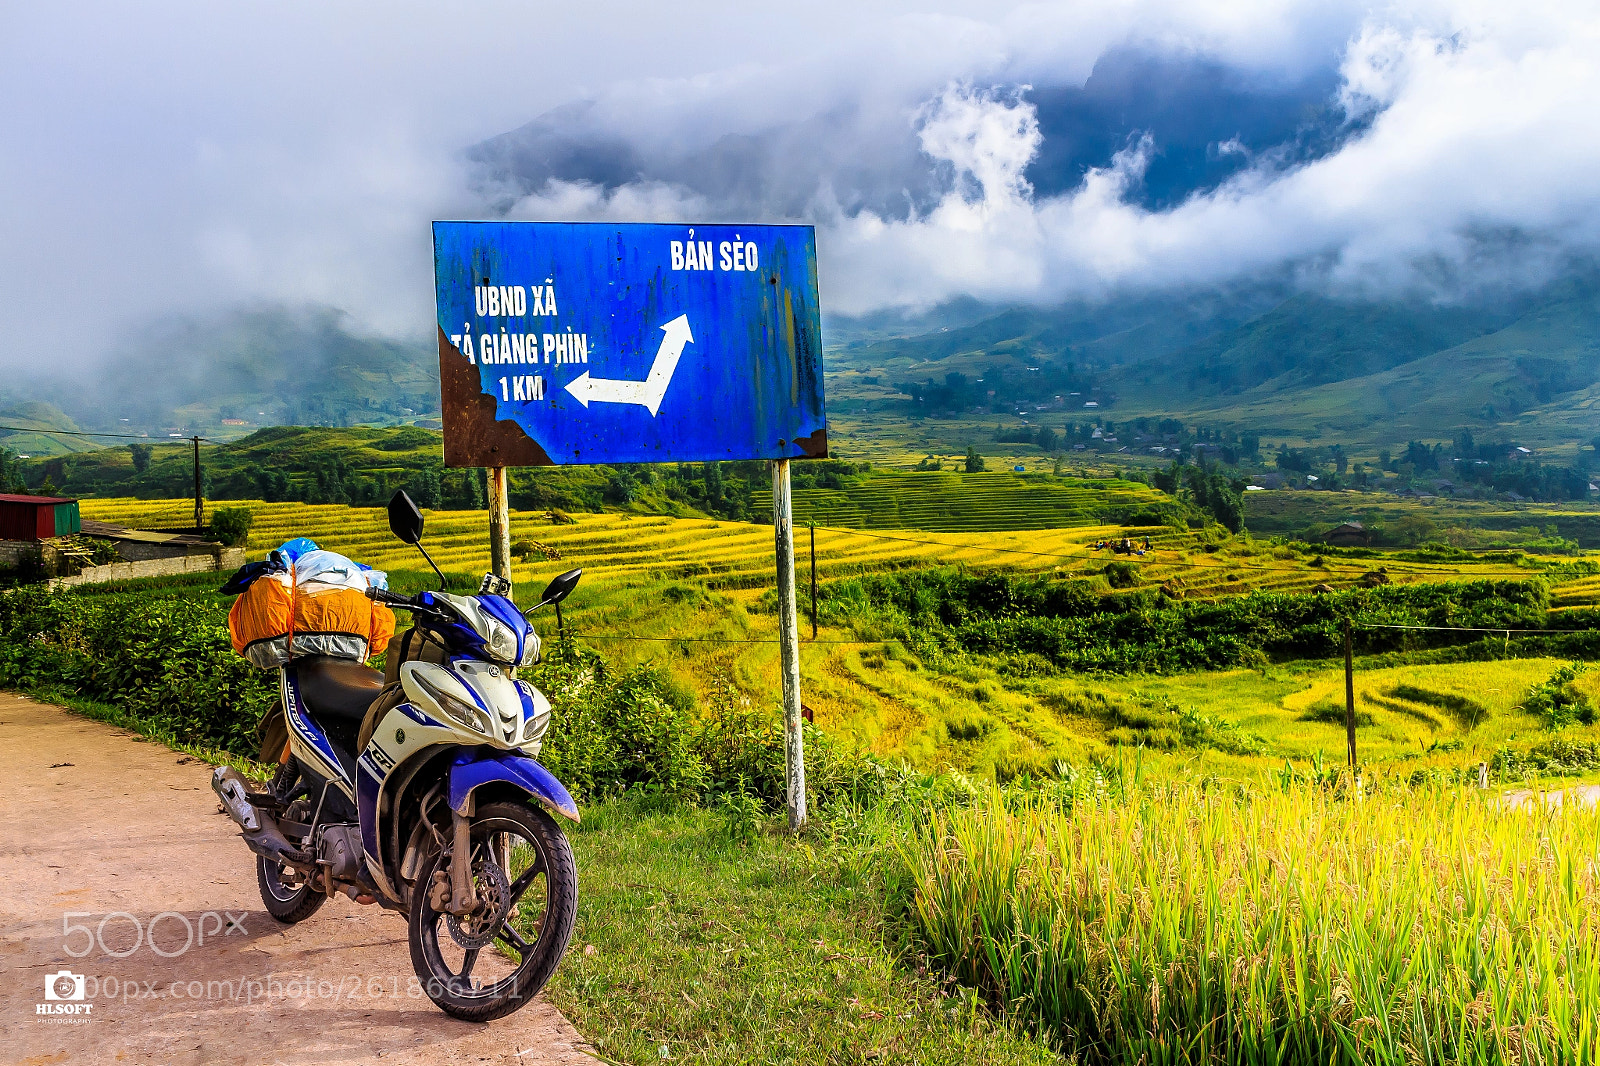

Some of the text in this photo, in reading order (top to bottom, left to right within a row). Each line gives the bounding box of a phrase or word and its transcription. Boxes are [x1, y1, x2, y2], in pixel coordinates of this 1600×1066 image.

[670, 228, 759, 272] BẢN SÈO
[474, 277, 558, 317] UBND XÃ
[480, 326, 539, 365] GIÀNG
[542, 326, 588, 364] PHÌN
[498, 375, 544, 402] 1 KM
